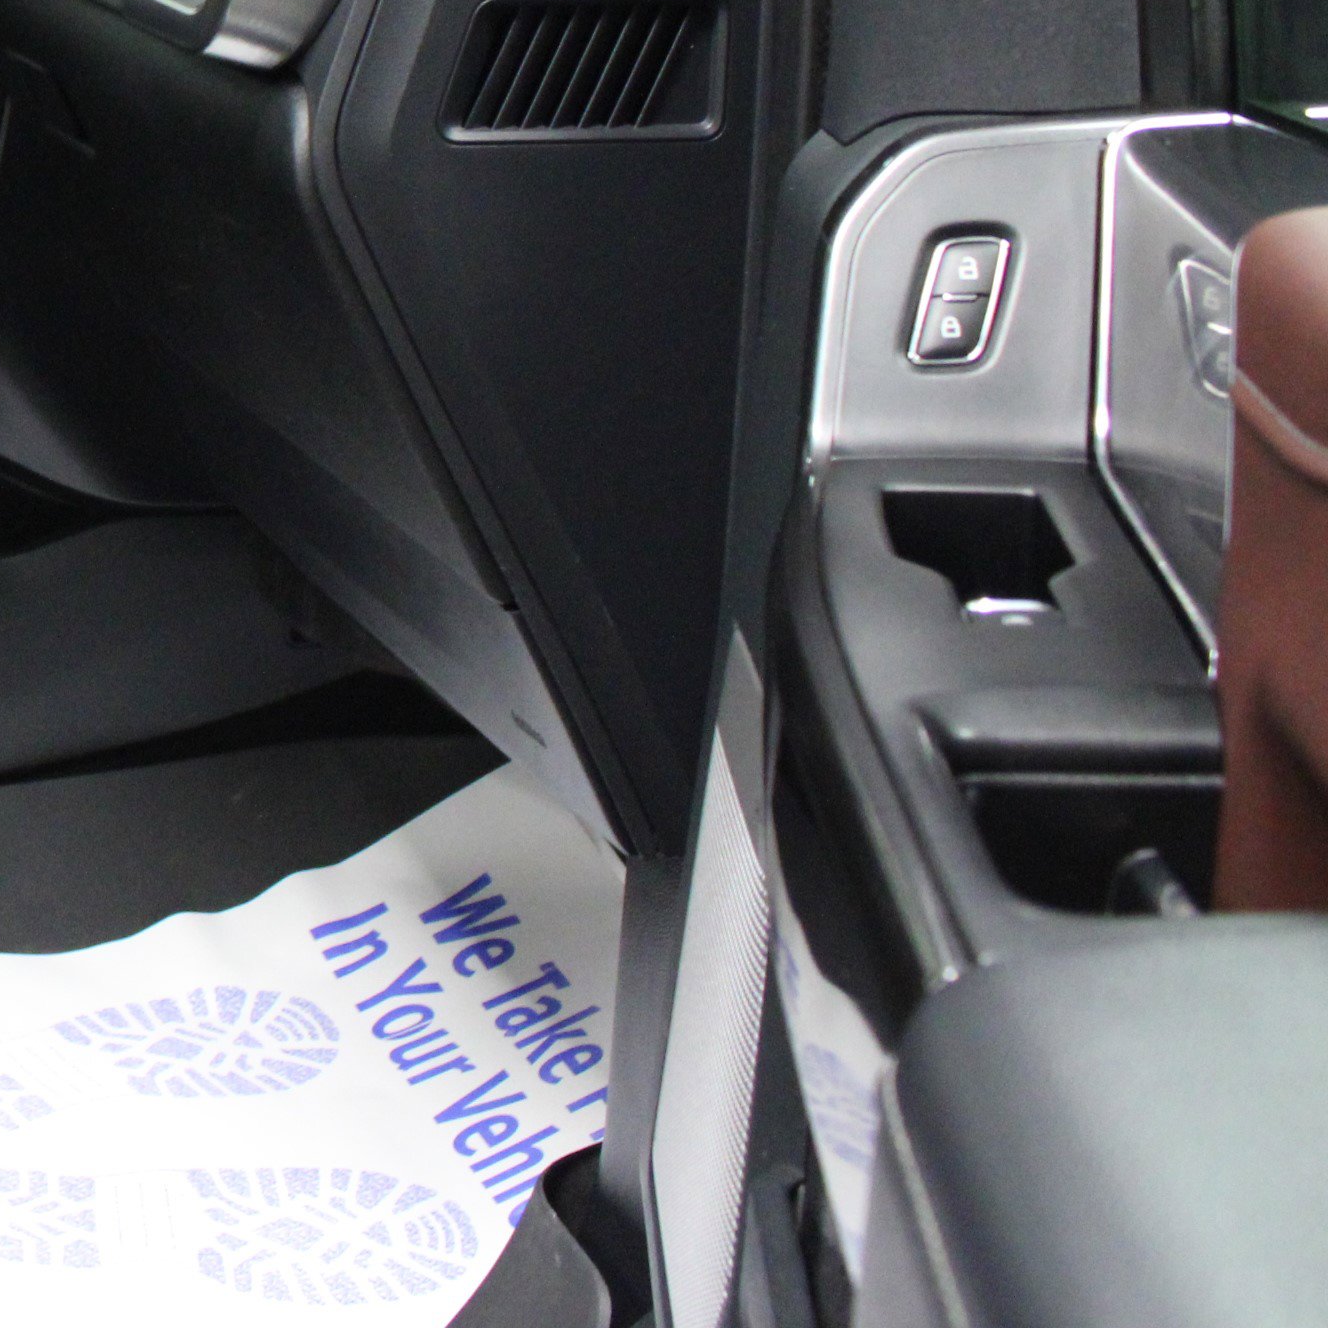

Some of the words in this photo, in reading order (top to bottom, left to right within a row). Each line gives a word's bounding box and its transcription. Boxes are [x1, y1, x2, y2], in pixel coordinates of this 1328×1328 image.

[309, 901, 390, 980] In
[355, 956, 477, 1087] Your
[433, 1068, 561, 1230] Vehi
[419, 872, 521, 978] We
[481, 960, 604, 1085] Take
